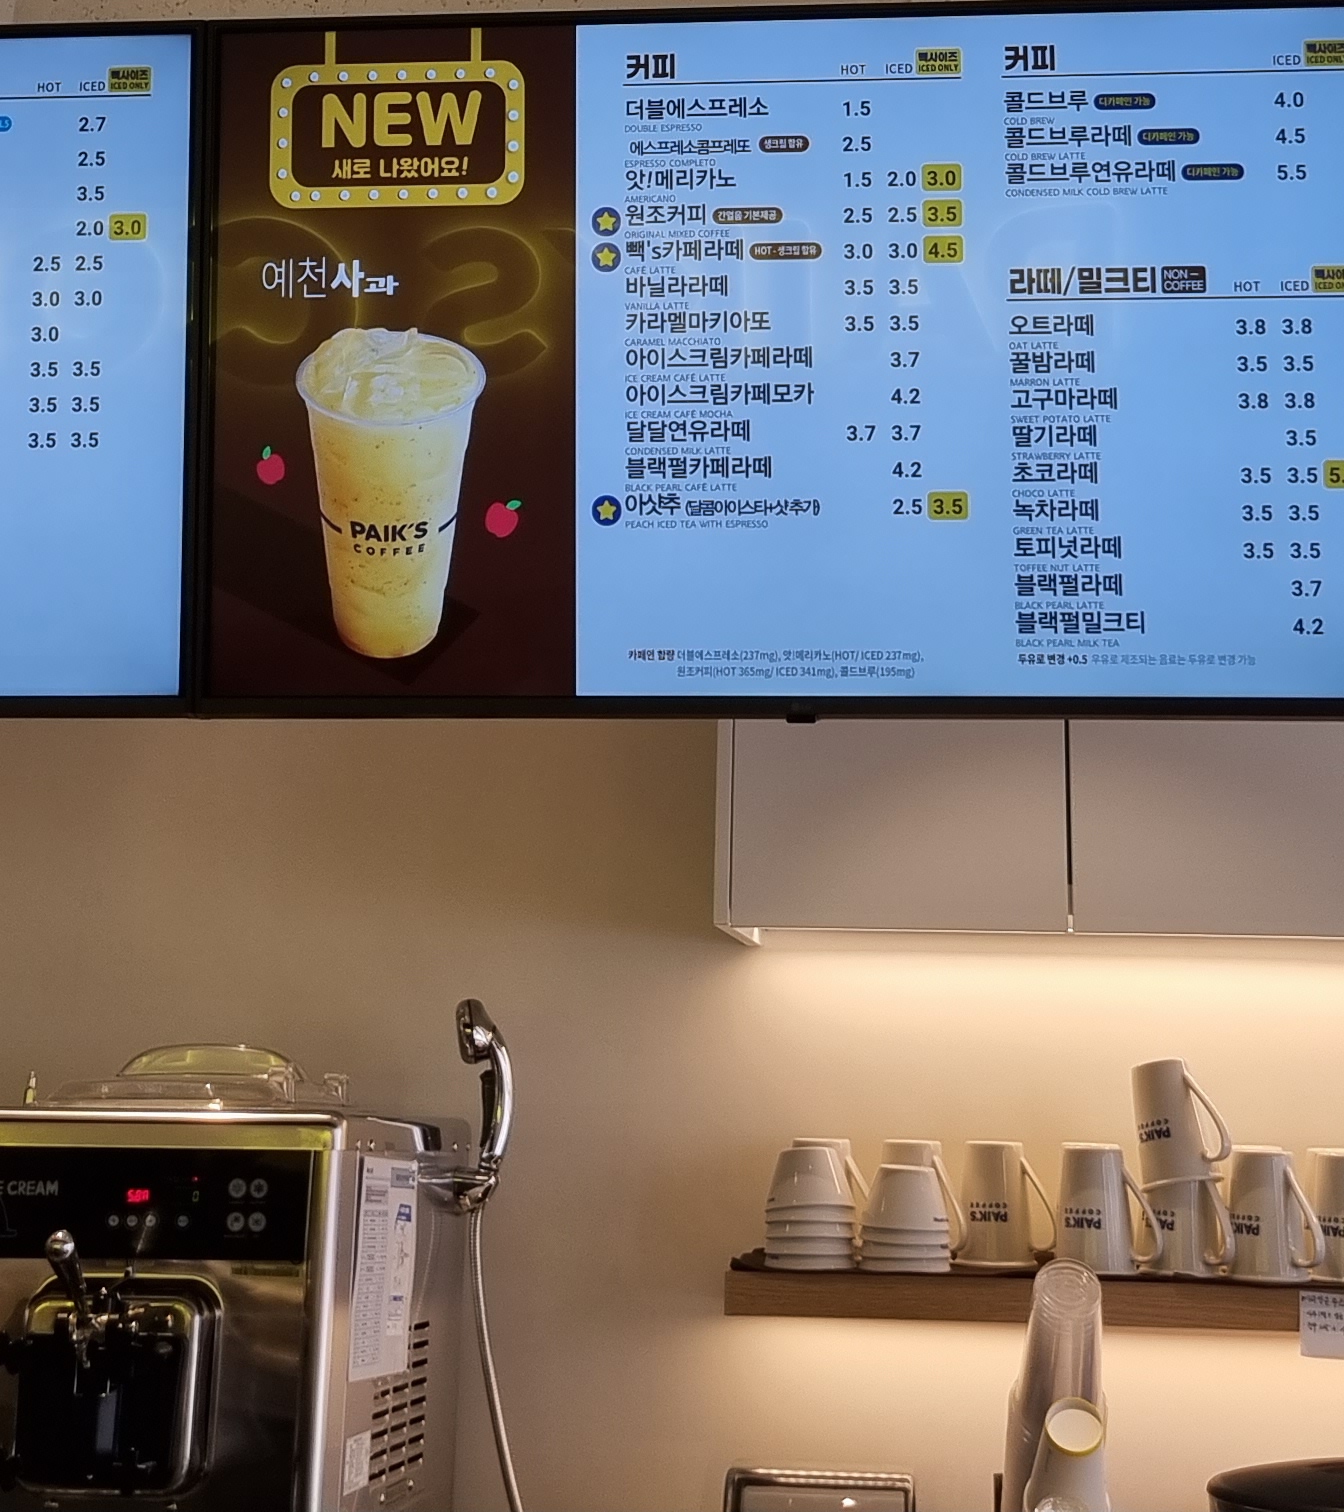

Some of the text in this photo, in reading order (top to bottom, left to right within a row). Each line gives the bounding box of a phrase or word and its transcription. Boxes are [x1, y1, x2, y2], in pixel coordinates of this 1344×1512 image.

[626, 53, 675, 80] 커피
[1004, 44, 1055, 72] 커피
[38, 81, 105, 93] HOT ICED
[626, 97, 871, 120] 더블에스프레소 1.5
[1004, 90, 1088, 112] 콜드브루
[78, 117, 106, 132] 2.7
[321, 90, 482, 148] NEW
[624, 124, 702, 132] DOUBLE ESPRESSO
[1004, 125, 1132, 148] 콜드브루라떼
[332, 156, 468, 179] 새로 나왔어요!
[1005, 160, 1306, 184] 콜드브루연유라떼 5.5
[626, 168, 956, 191] 앗!메리카노 1.5 3.0
[625, 195, 675, 203] AMERICANO
[625, 204, 706, 227] 원조커피
[113, 220, 142, 236] 3.0
[928, 242, 957, 258] 4.5
[262, 257, 399, 298] 예천사과
[625, 275, 728, 298] 바닐라라떼
[1009, 266, 1156, 295] 라떼/밀크티
[1164, 280, 1204, 291] COFFEE
[625, 310, 771, 334] 카라멜마키아또
[1009, 314, 1094, 337] 오트라떼
[626, 346, 813, 370] 아이스크림카페라떼
[1010, 351, 1095, 374] 꿀밤라떼
[626, 382, 814, 406] 아이스크림카페모카
[1011, 387, 1118, 411] 고구마라떼
[626, 419, 750, 442] 달달연유라떼
[1012, 424, 1097, 448] 딸기라떼
[625, 456, 772, 479] 블랙펄카페라떼
[1012, 461, 1098, 484] 초코라떼
[626, 493, 963, 516] 아샷추 3.5
[1013, 499, 1100, 522] 녹차라떼
[350, 520, 428, 542] PAIK'S
[354, 543, 425, 556] COFFEE
[1014, 536, 1122, 559] 토피넛라떼
[1015, 573, 1123, 597] 블랙펄라떼
[1015, 611, 1324, 635] 블랙펄밀크티 4.2
[7, 1180, 58, 1195] CREAM
[970, 1210, 1008, 1223] PAIK'S
